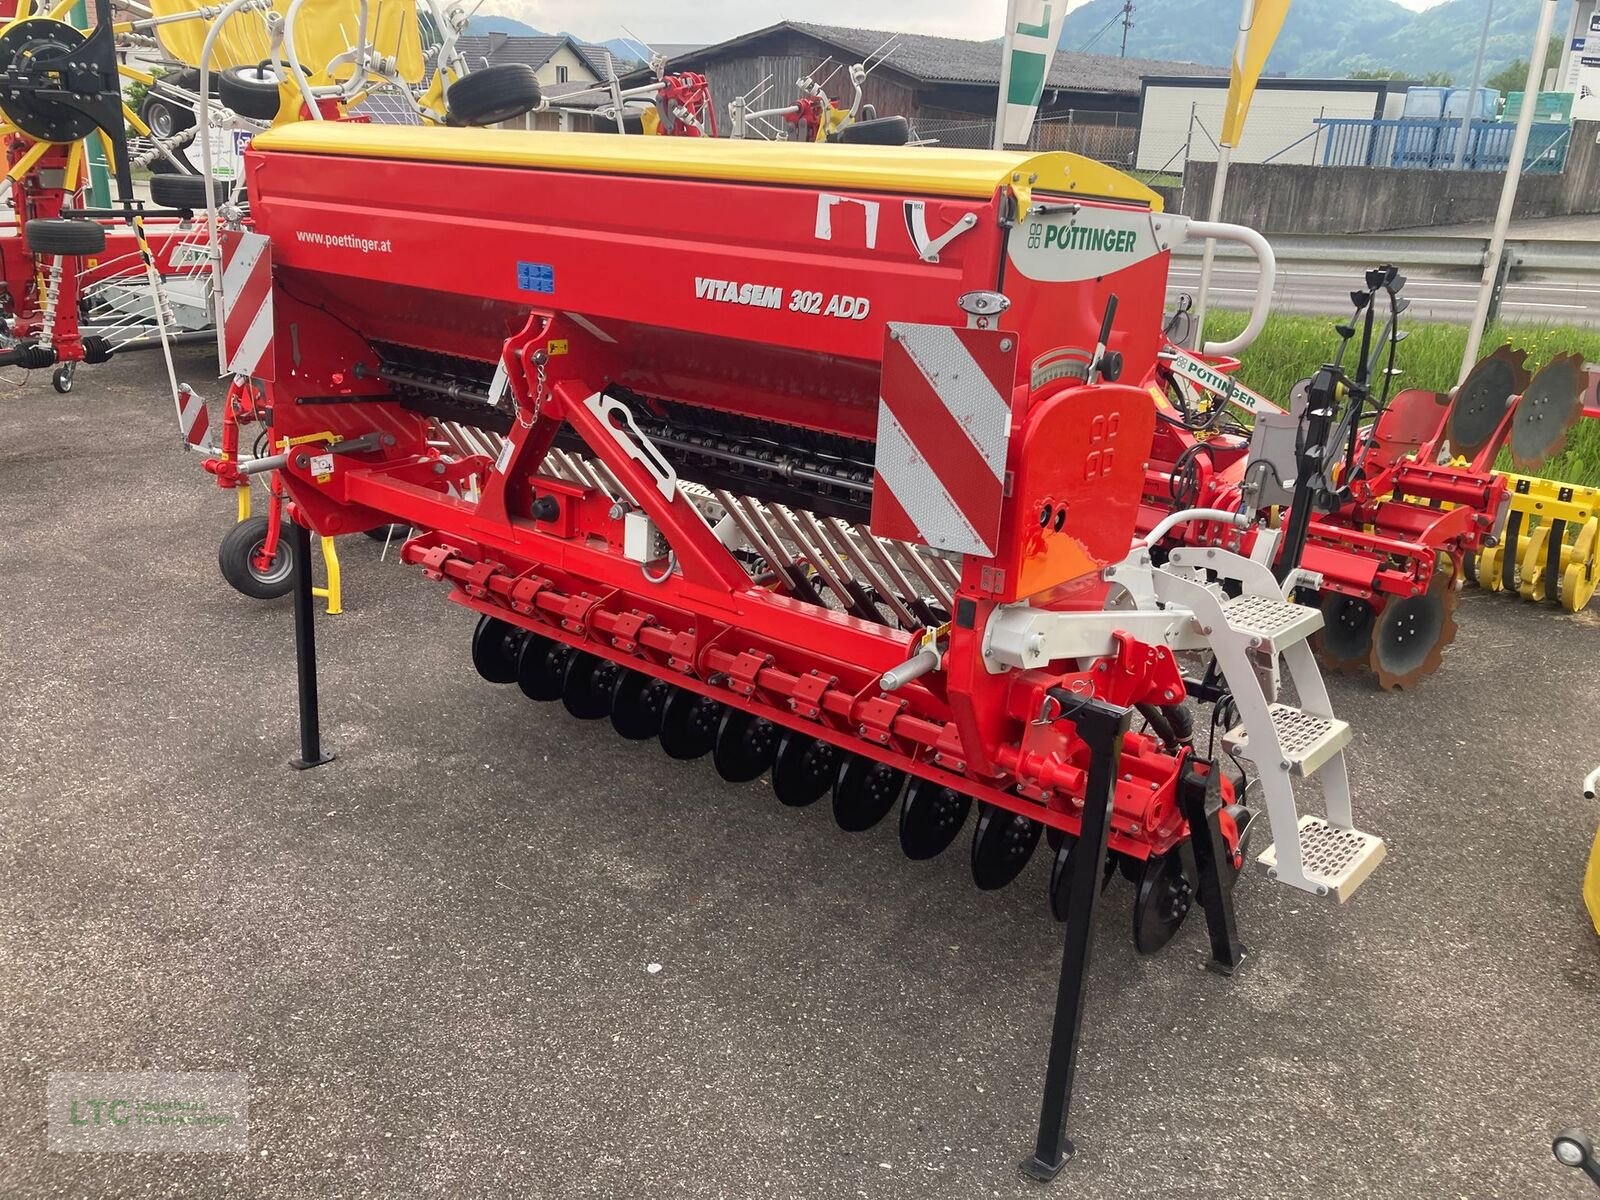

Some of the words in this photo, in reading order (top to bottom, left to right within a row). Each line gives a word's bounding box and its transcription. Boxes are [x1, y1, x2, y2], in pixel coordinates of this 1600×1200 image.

[296, 230, 393, 253] www.poettinger.at
[694, 277, 783, 310] VITASEM
[788, 289, 824, 315] 302
[823, 294, 871, 321] ADD
